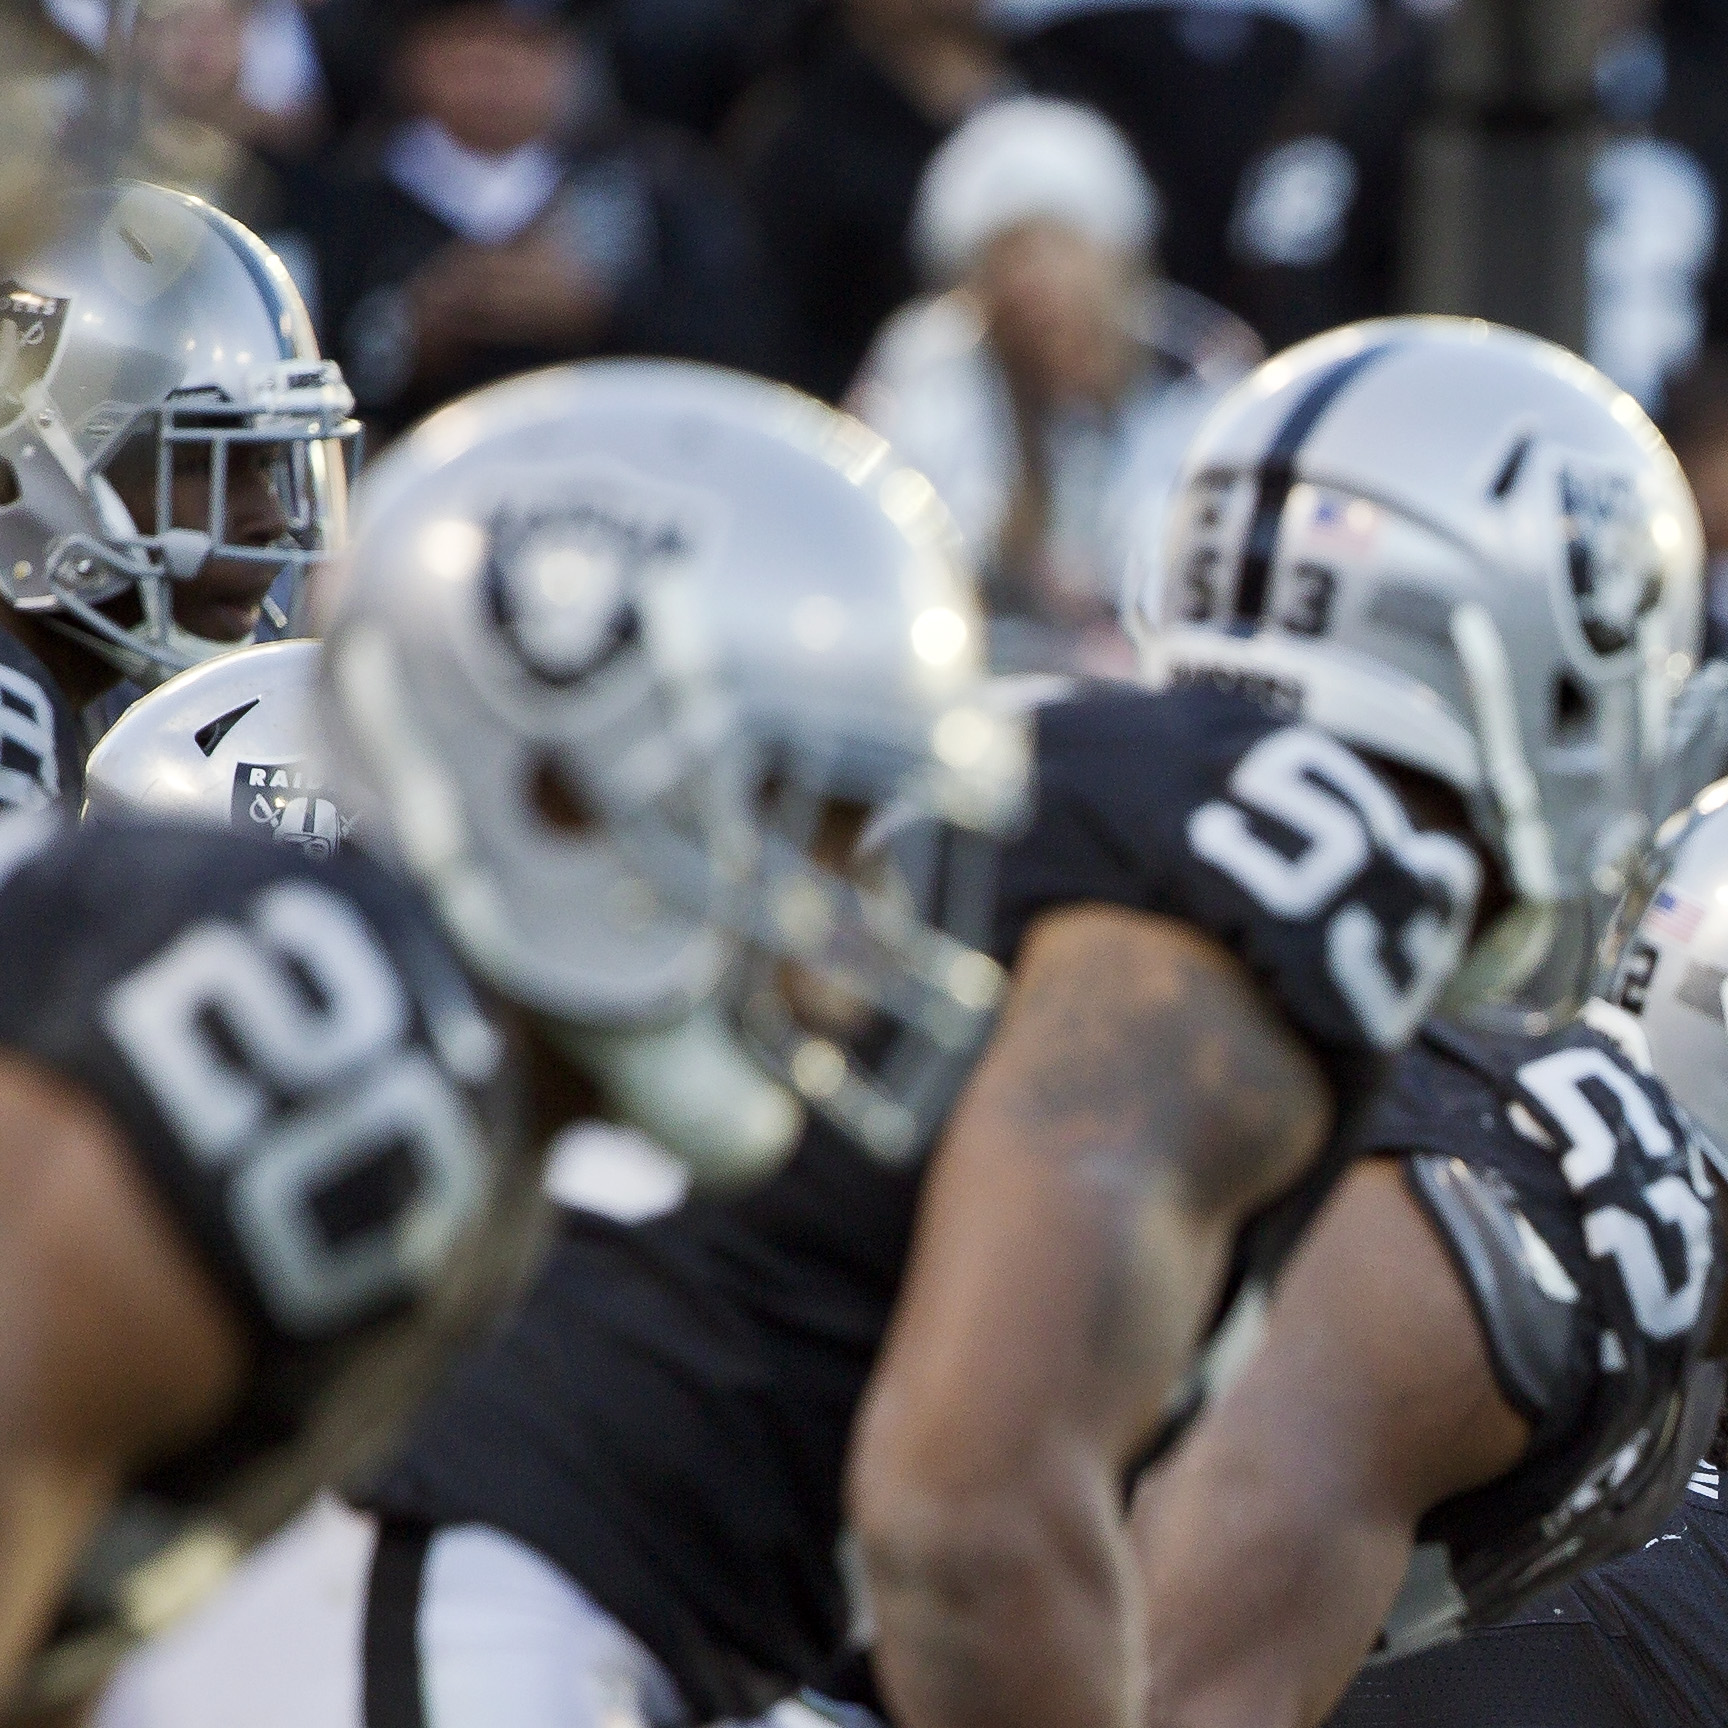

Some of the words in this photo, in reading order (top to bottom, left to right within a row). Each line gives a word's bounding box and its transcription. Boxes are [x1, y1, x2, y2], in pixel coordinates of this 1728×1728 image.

[1186, 727, 1484, 1050] 53
[106, 882, 488, 1338] 20
[1514, 1047, 1713, 1341] 52
